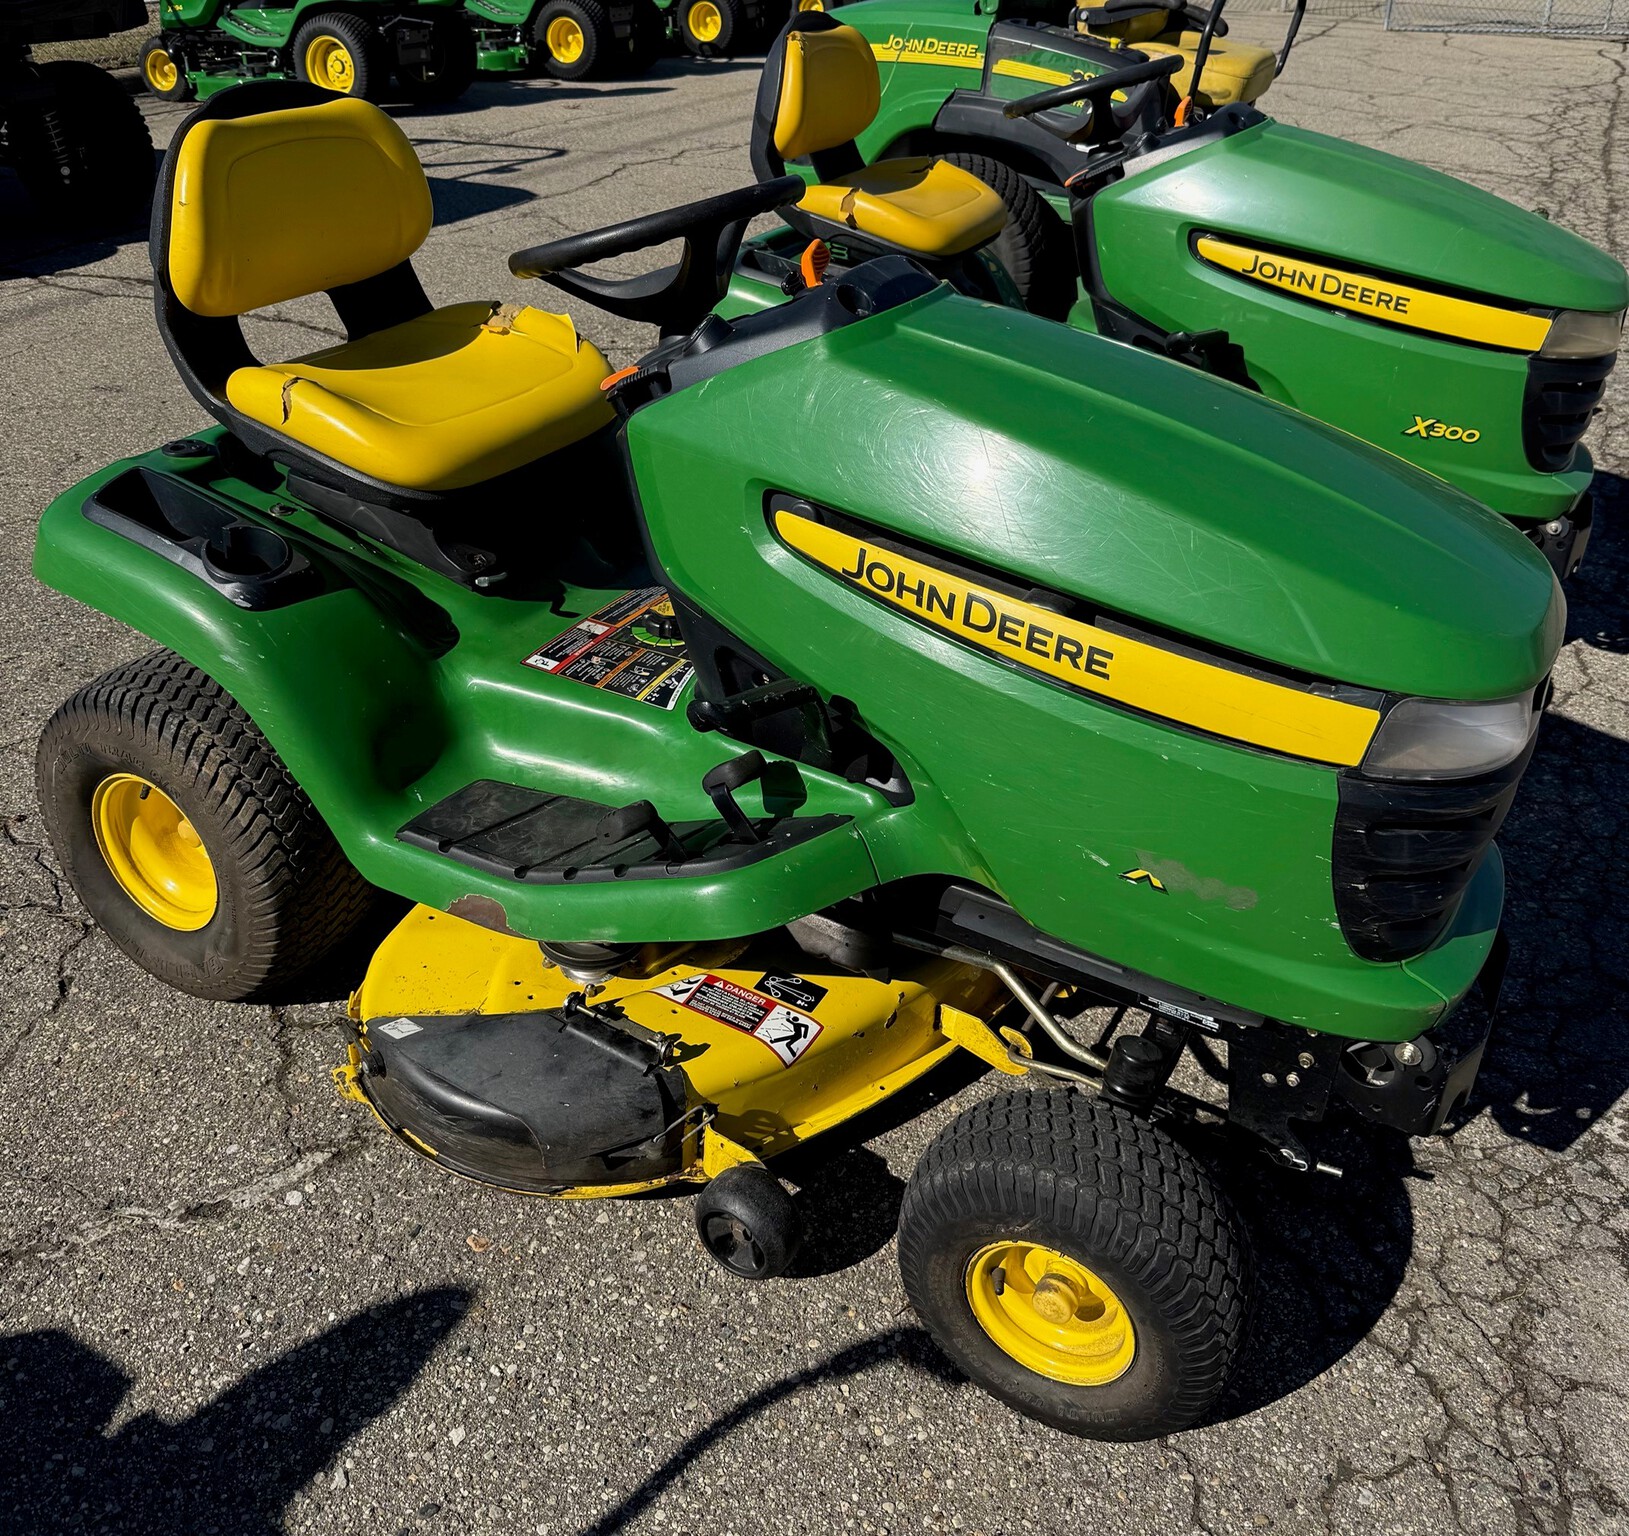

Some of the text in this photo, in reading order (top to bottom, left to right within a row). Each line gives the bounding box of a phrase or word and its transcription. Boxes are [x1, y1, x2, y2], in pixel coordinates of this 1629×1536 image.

[882, 34, 979, 57] JOHN DEERE
[1241, 254, 1411, 315] JOHN DEERE
[1402, 414, 1481, 443] X300
[841, 547, 1114, 681] JOHN DEERE
[724, 983, 767, 1006] DANGER
